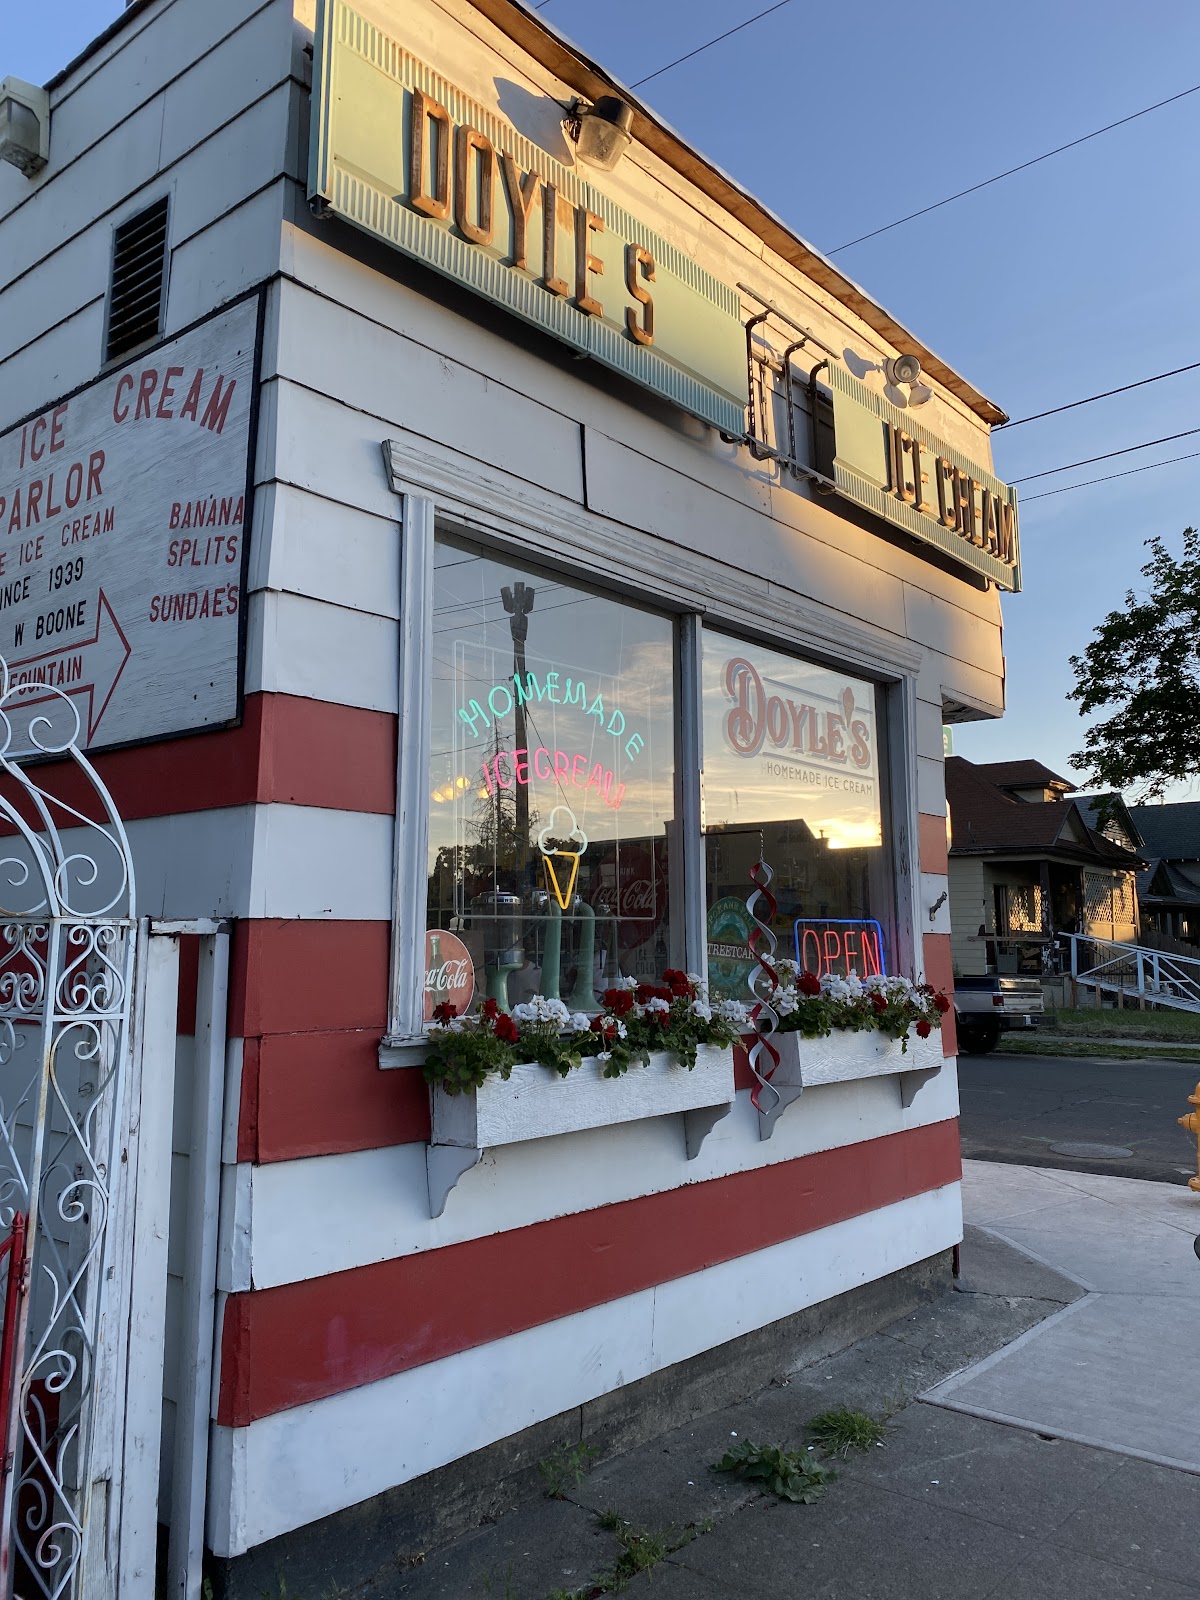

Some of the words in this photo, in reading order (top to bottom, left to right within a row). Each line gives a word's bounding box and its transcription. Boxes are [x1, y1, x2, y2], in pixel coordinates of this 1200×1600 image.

[20, 402, 69, 469] ICE
[113, 366, 237, 435] CREAM
[168, 496, 244, 529] BANANA
[888, 421, 931, 514] ICE
[936, 455, 1017, 567] CREAM
[19, 535, 44, 566] ICE
[61, 506, 115, 547] CREAM
[167, 535, 238, 566] SPLITS
[0, 575, 31, 611] INCE
[48, 557, 84, 592] 1939
[14, 622, 25, 648] W
[35, 600, 87, 640] BOONE
[9, 655, 82, 698] FOUNTAIN
[458, 672, 645, 762] HOMEMADE
[766, 762, 821, 785] HOMEMADE
[824, 775, 840, 790] ICE
[843, 780, 873, 796] CREAM
[618, 867, 635, 876] RINK
[707, 943, 755, 960] TREETCAR
[802, 929, 881, 980] OPEN
[425, 958, 468, 992] a-Cola
